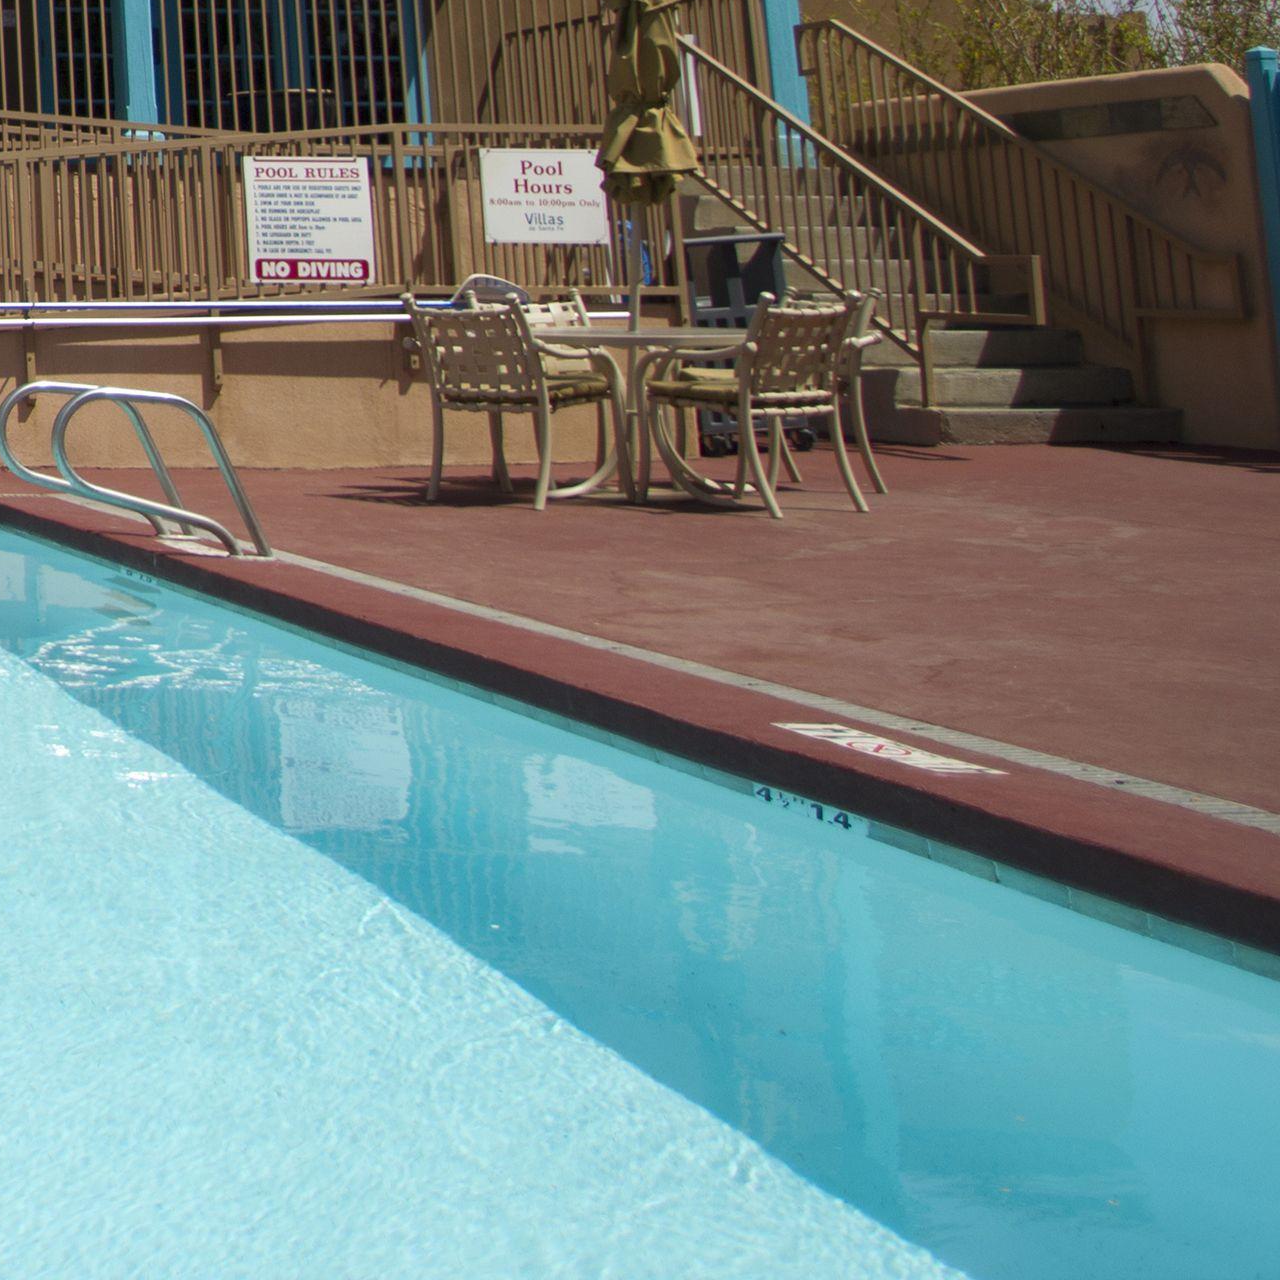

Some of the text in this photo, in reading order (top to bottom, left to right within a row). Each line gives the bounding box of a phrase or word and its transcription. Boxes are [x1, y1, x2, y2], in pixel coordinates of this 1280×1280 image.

[255, 167, 360, 179] POOL RULES
[520, 160, 563, 176] Pool
[513, 179, 573, 194] Hours
[525, 198, 535, 206] to
[579, 199, 600, 208] Only
[525, 212, 564, 225] Villas
[262, 261, 364, 278] NO DIVING
